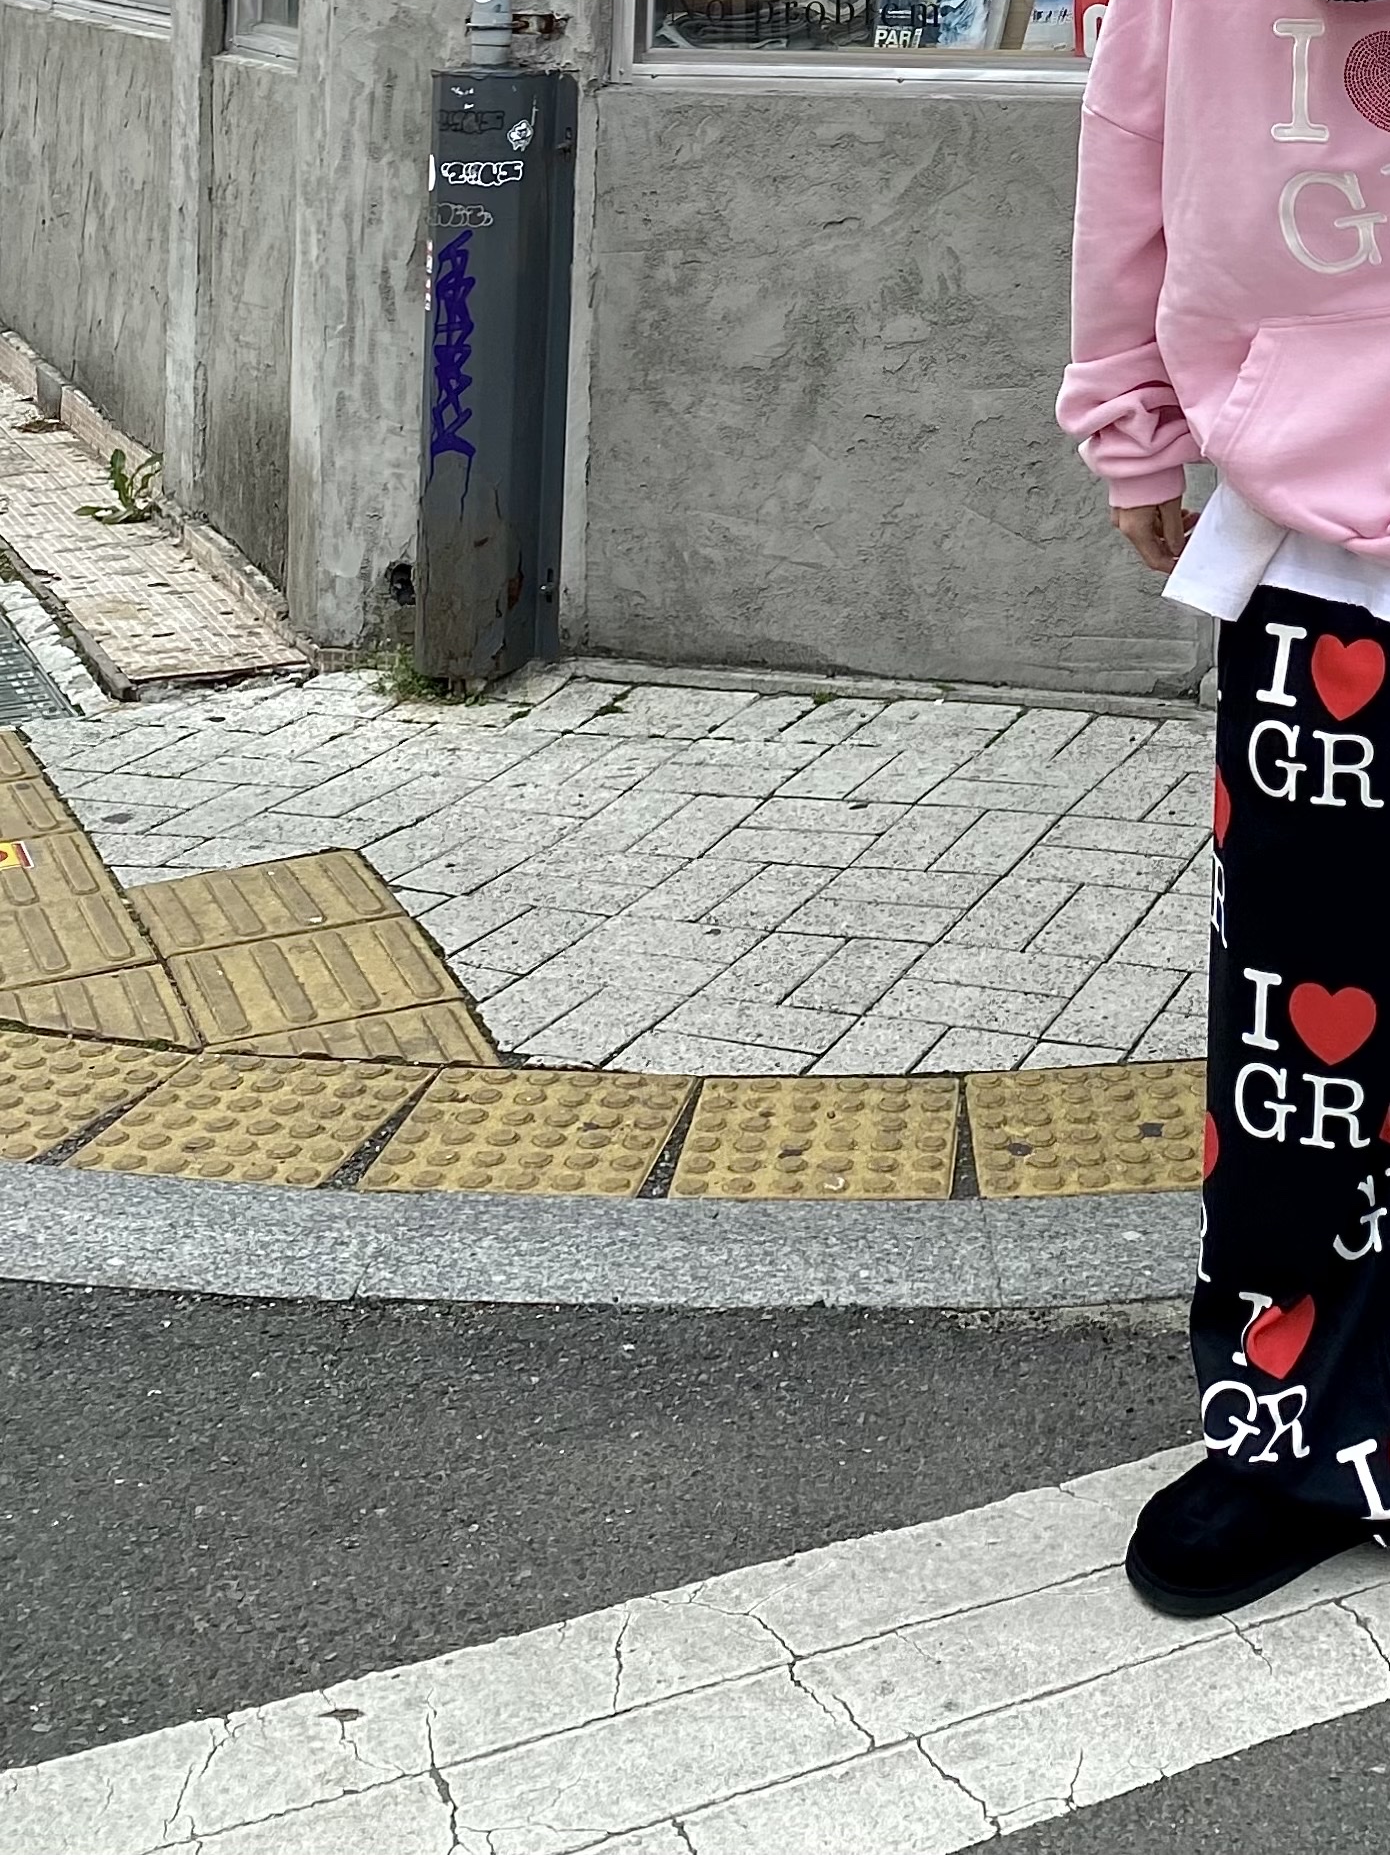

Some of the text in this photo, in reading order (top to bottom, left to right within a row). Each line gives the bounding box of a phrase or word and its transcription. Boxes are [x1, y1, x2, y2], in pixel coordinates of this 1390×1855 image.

[1270, 17, 1330, 143] I
[1255, 622, 1308, 708] I
[1247, 719, 1385, 810] GR
[1242, 967, 1283, 1051] I
[1234, 1061, 1371, 1150] GR
[1201, 1379, 1311, 1464] GR
